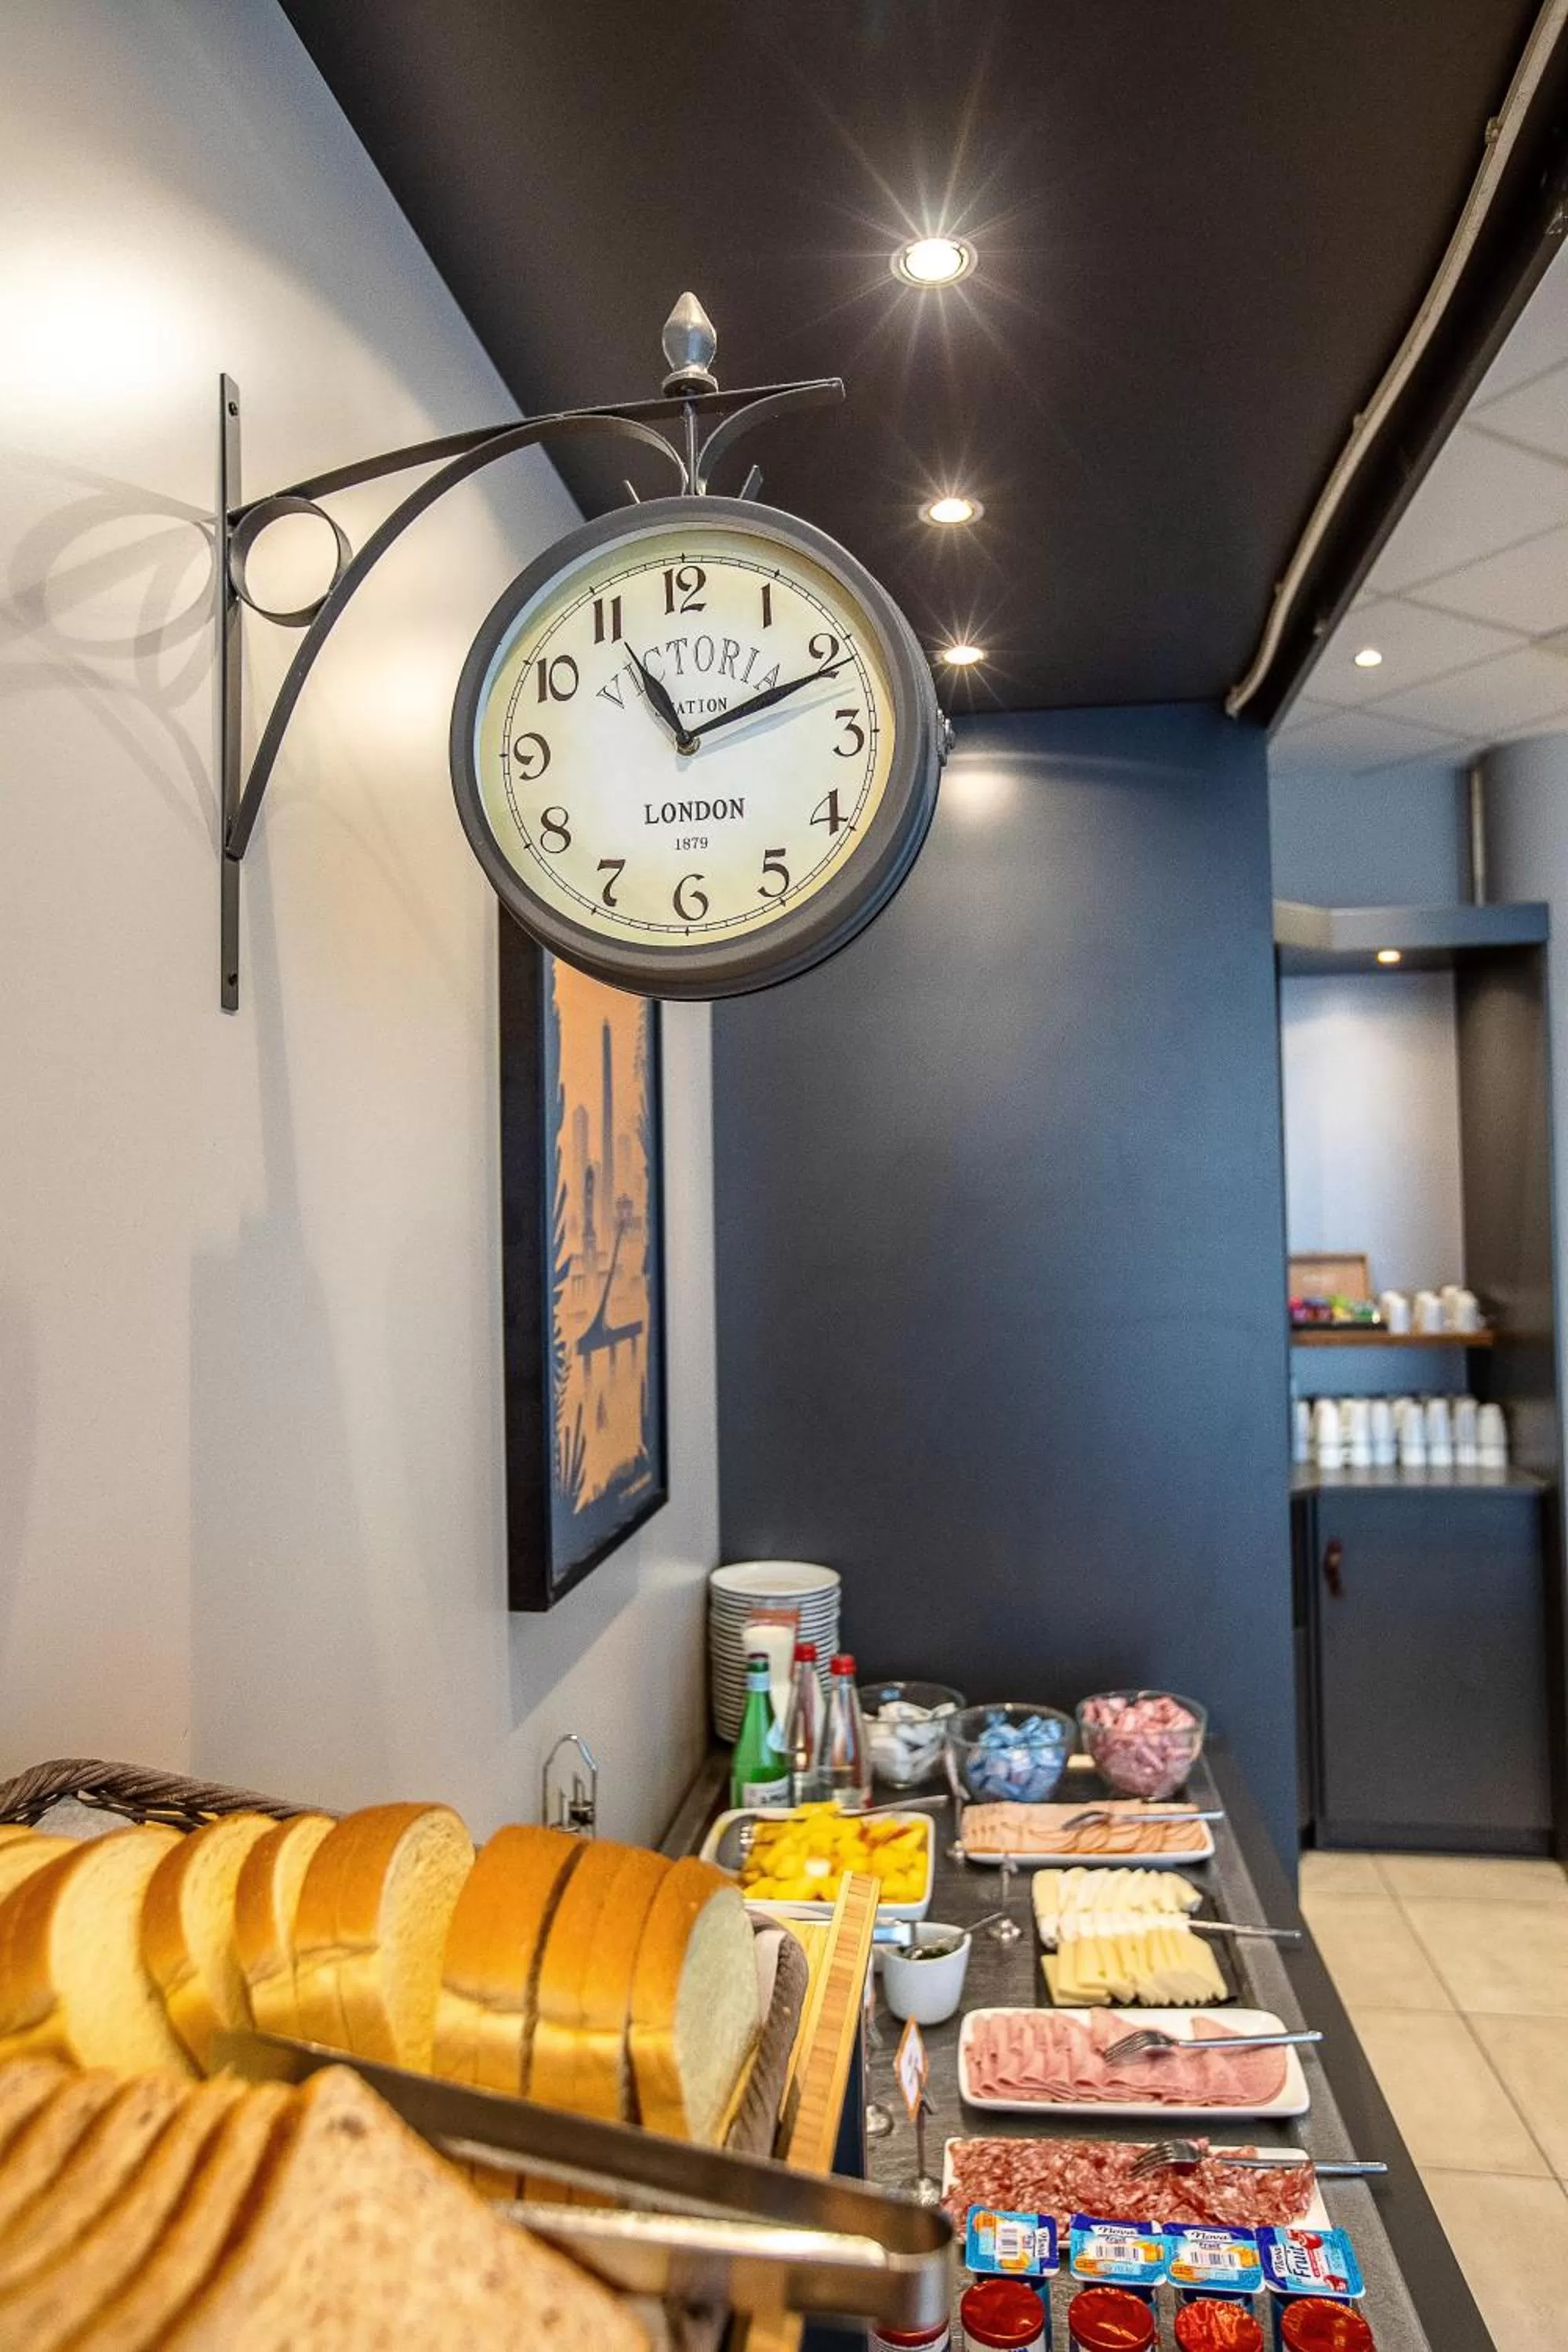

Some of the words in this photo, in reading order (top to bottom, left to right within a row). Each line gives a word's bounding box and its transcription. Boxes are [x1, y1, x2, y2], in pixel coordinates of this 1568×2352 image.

[664, 565, 706, 615] 12
[761, 583, 771, 628] 1
[593, 596, 623, 644] 11
[536, 655, 579, 702] 10
[596, 635, 780, 709] VICTORIA
[808, 633, 840, 678] 2
[655, 697, 728, 717] ATION
[514, 733, 550, 780] 9
[833, 710, 864, 757] 3
[539, 806, 572, 854] 8
[644, 798, 746, 825] LONDON
[810, 789, 848, 836] 4
[675, 837, 709, 851] 1879
[597, 859, 626, 907] 7
[757, 848, 790, 898] 5
[673, 873, 709, 921] 6
[1287, 2245, 1311, 2279] Fruit
